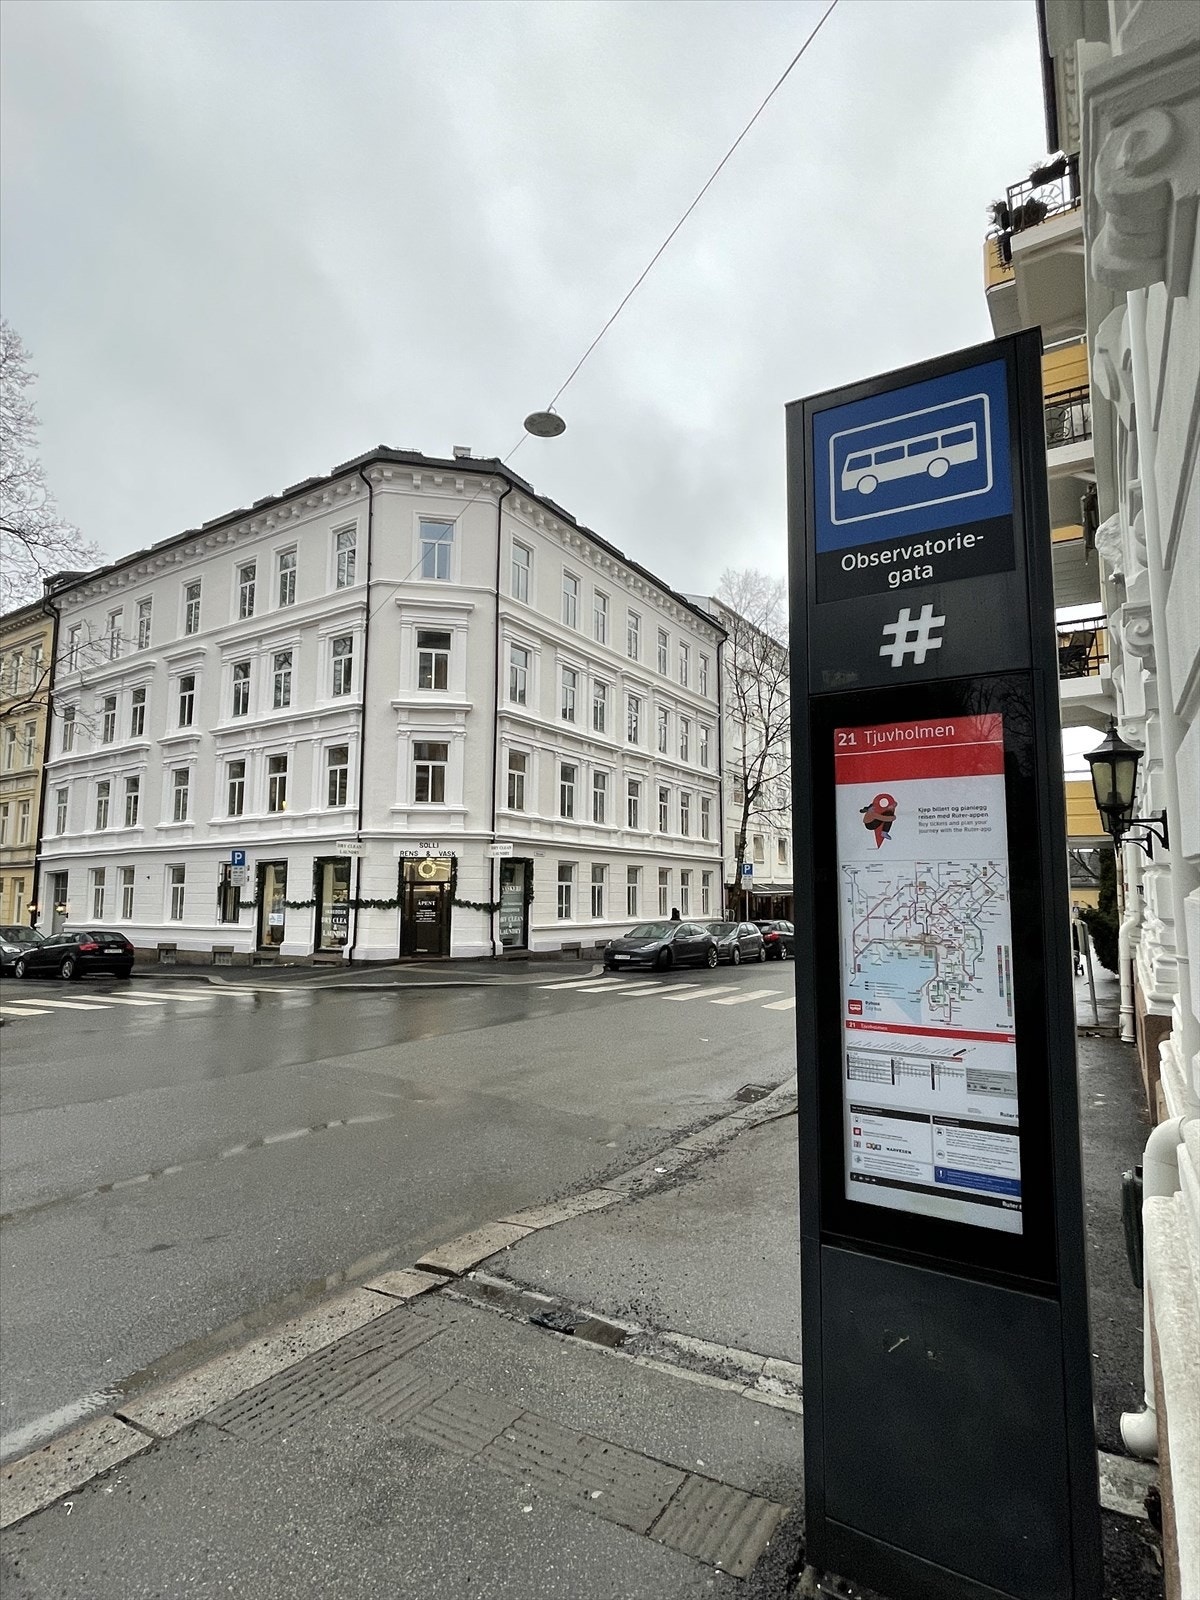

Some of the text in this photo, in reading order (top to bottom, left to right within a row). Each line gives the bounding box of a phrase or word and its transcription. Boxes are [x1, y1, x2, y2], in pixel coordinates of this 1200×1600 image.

[841, 532, 984, 572] Observatorie-
[888, 562, 934, 589] gata
[838, 724, 955, 746] 21 Tjuvholmen
[234, 852, 242, 864] P
[744, 865, 750, 874] P
[1002, 1201, 1018, 1209] Ruter
